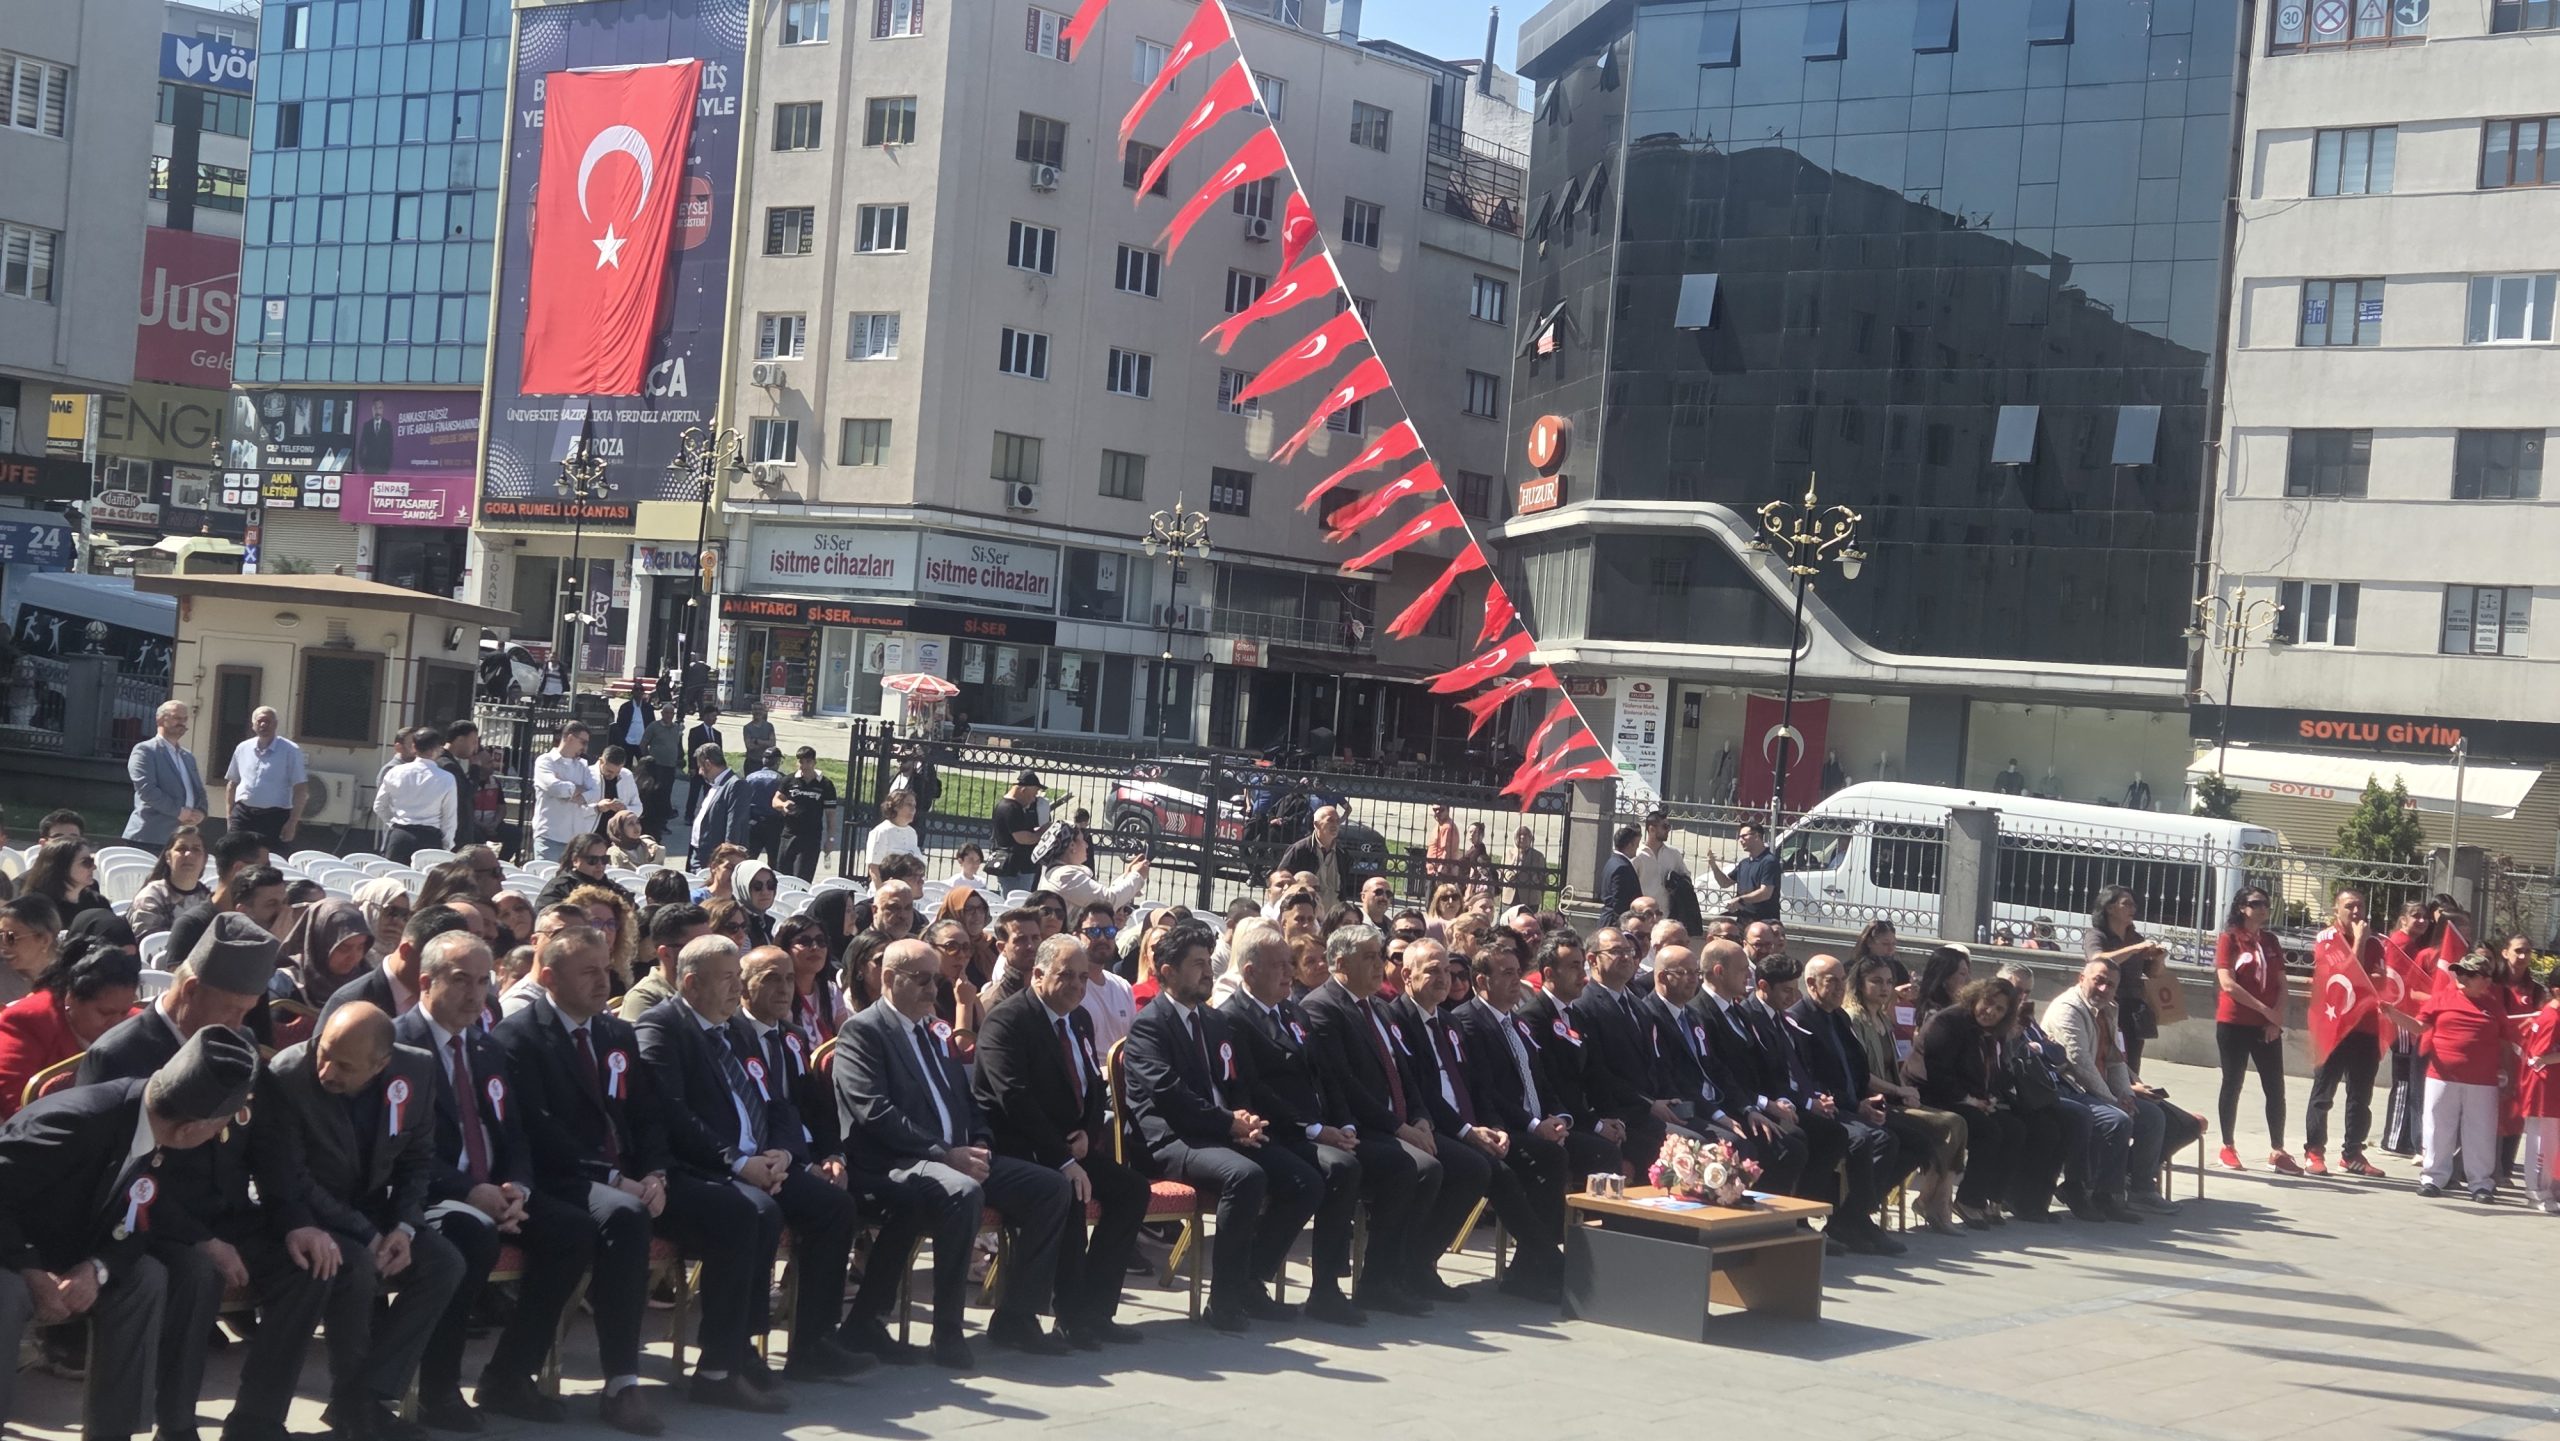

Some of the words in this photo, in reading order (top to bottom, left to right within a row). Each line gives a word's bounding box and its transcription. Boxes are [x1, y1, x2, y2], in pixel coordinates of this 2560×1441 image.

[2283, 12, 2299, 25] 30
[139, 267, 239, 335] Jus
[271, 473, 292, 484] AKIN
[262, 484, 298, 499] İLETİŞİM
[376, 485, 406, 495] SİNPAŞ
[1522, 483, 1555, 506] HUZUR
[373, 498, 394, 508] YAPI
[395, 499, 439, 510] TASARRUF
[484, 502, 516, 515] GORA
[519, 501, 561, 517] RUMELİ
[403, 510, 438, 520] SANDIĞI
[28, 525, 61, 550] 24
[814, 533, 853, 551] Si-Ser
[770, 550, 820, 575] işitme
[823, 552, 895, 577] cihazları
[971, 545, 1010, 565] Si-Ser
[926, 557, 978, 585] işitme
[981, 565, 1049, 595] cihazları
[723, 601, 797, 616] ANAHTARCI
[808, 605, 851, 622] Sİ-SER
[964, 617, 1007, 637] Sİ-SER
[806, 630, 819, 713] ANAHTARCI
[2299, 719, 2380, 742] SOYLU
[2386, 722, 2461, 746] GİYİM
[2269, 782, 2335, 799] SOYLU
[1215, 824, 1238, 840] LİS
